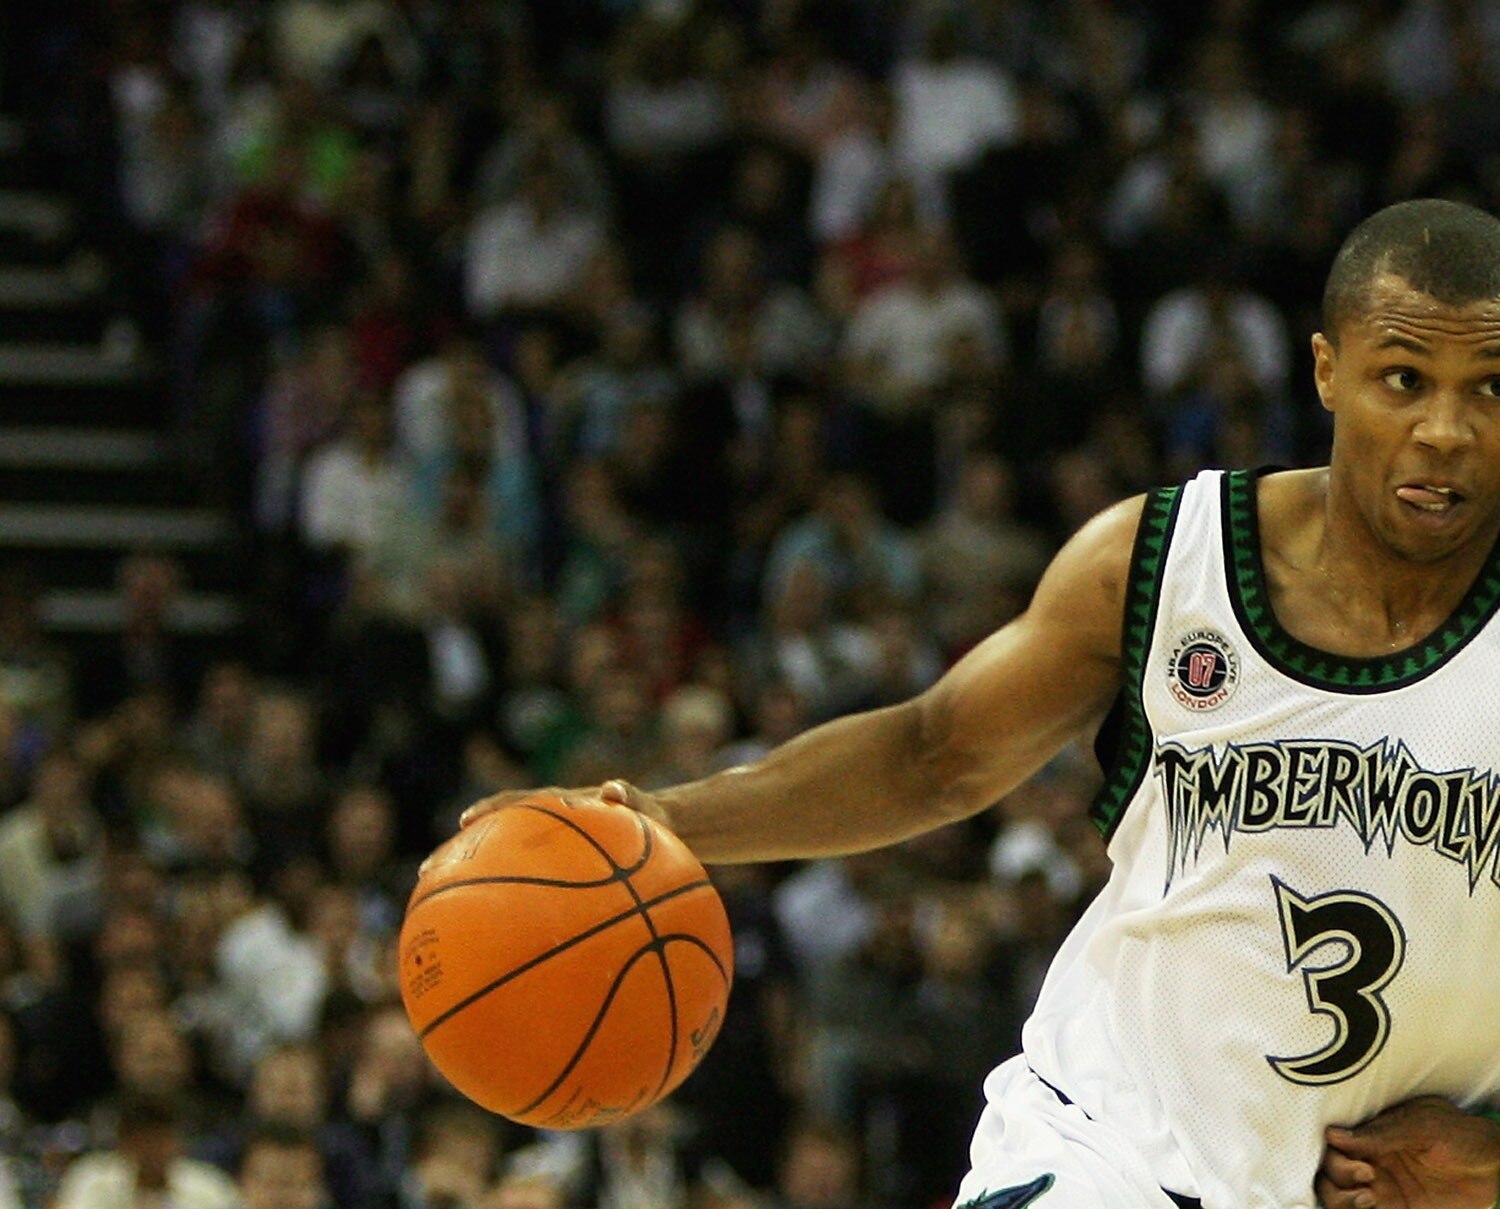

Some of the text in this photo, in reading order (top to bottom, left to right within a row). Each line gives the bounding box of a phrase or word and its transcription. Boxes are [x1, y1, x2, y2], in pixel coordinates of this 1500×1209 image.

[1168, 631, 1238, 684] NBA EUROPE LIVE
[1188, 652, 1217, 688] 07
[1171, 683, 1229, 708] LONDON
[1266, 874, 1406, 1086] 3
